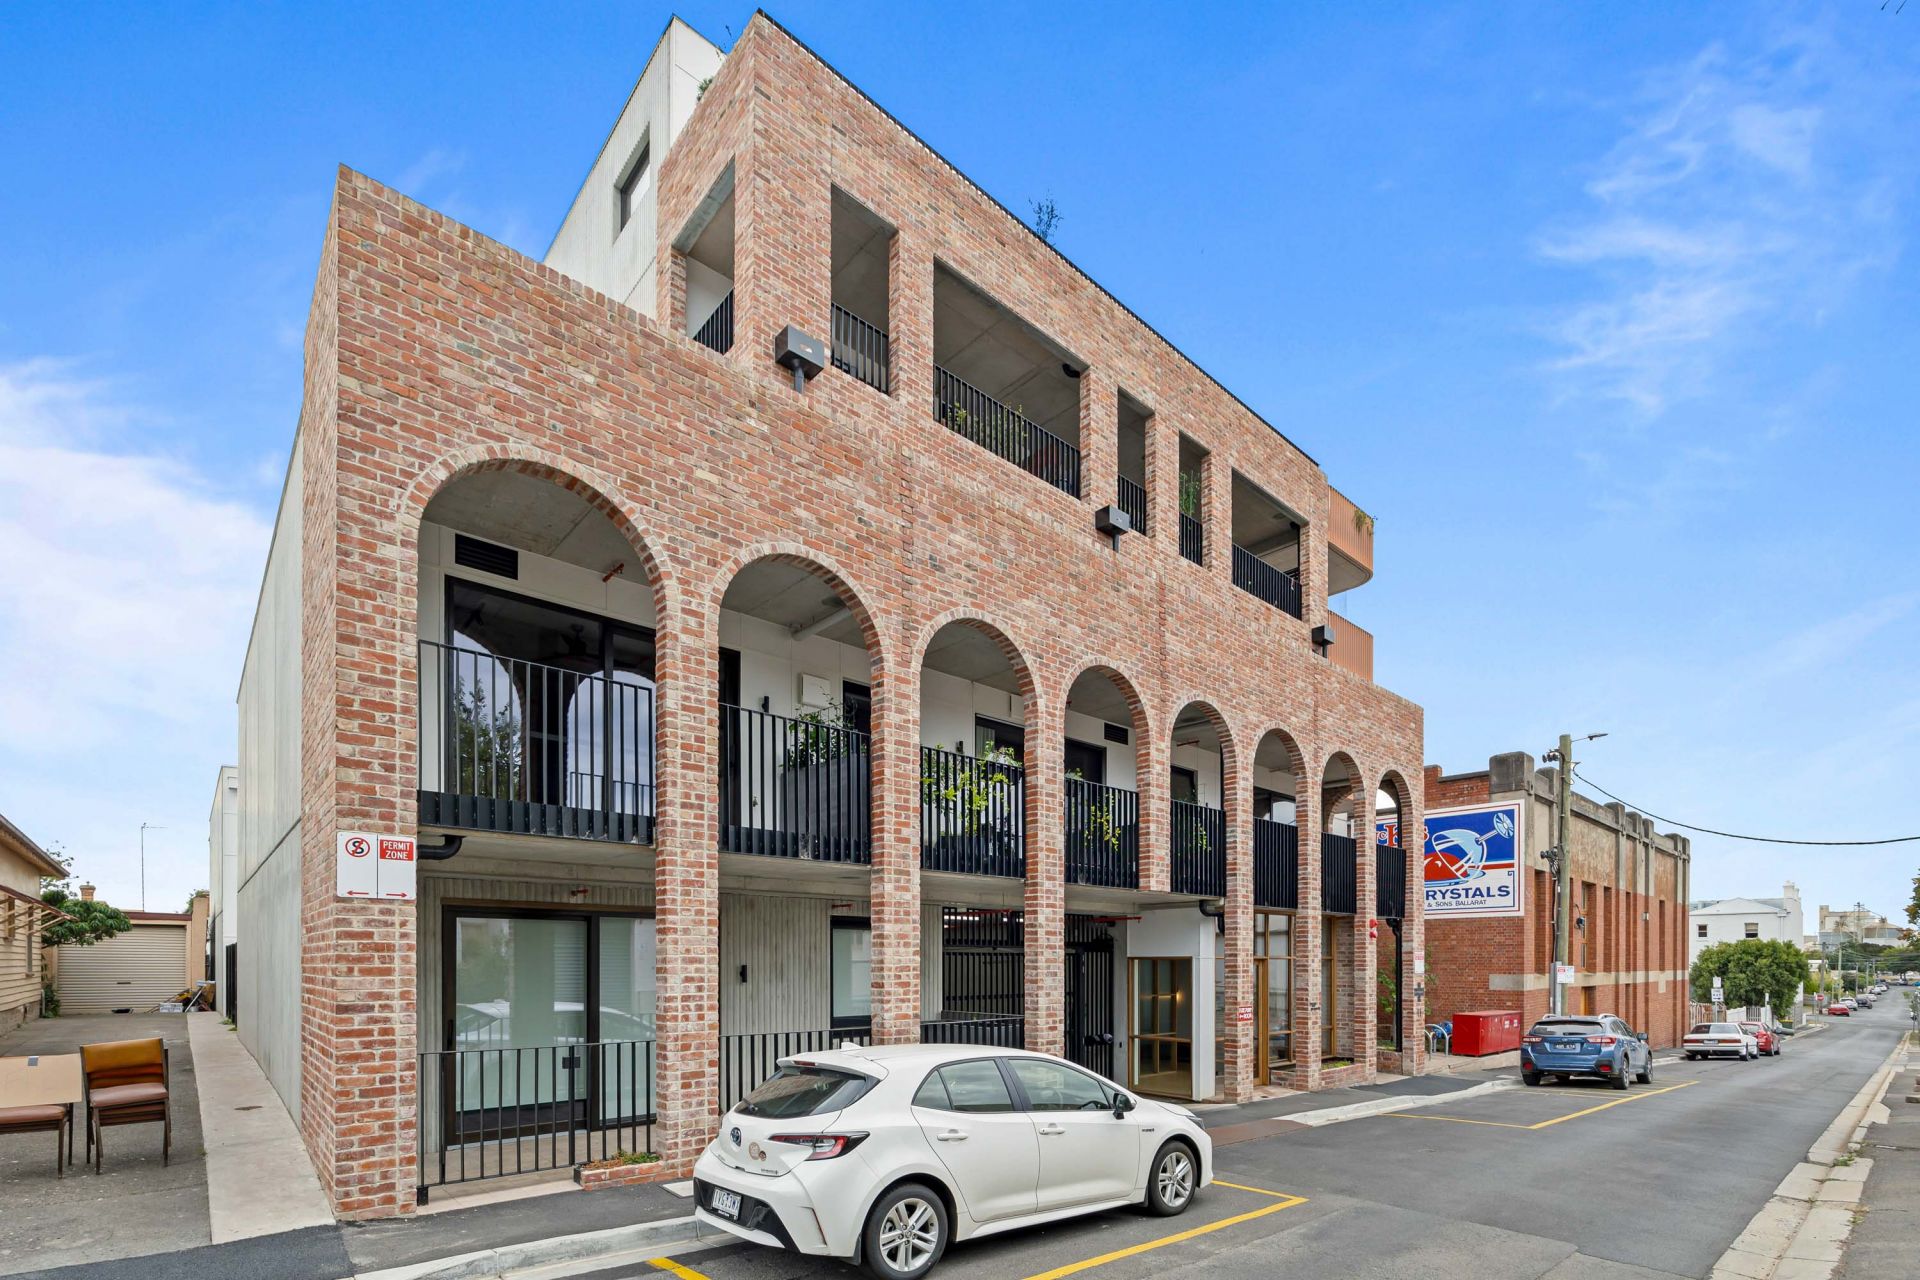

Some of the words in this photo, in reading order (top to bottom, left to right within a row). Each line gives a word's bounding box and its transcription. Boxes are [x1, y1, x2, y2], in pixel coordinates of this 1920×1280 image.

[383, 841, 410, 850] PERMIT
[385, 851, 408, 859] ZONE
[1425, 885, 1510, 900] RYSTALS
